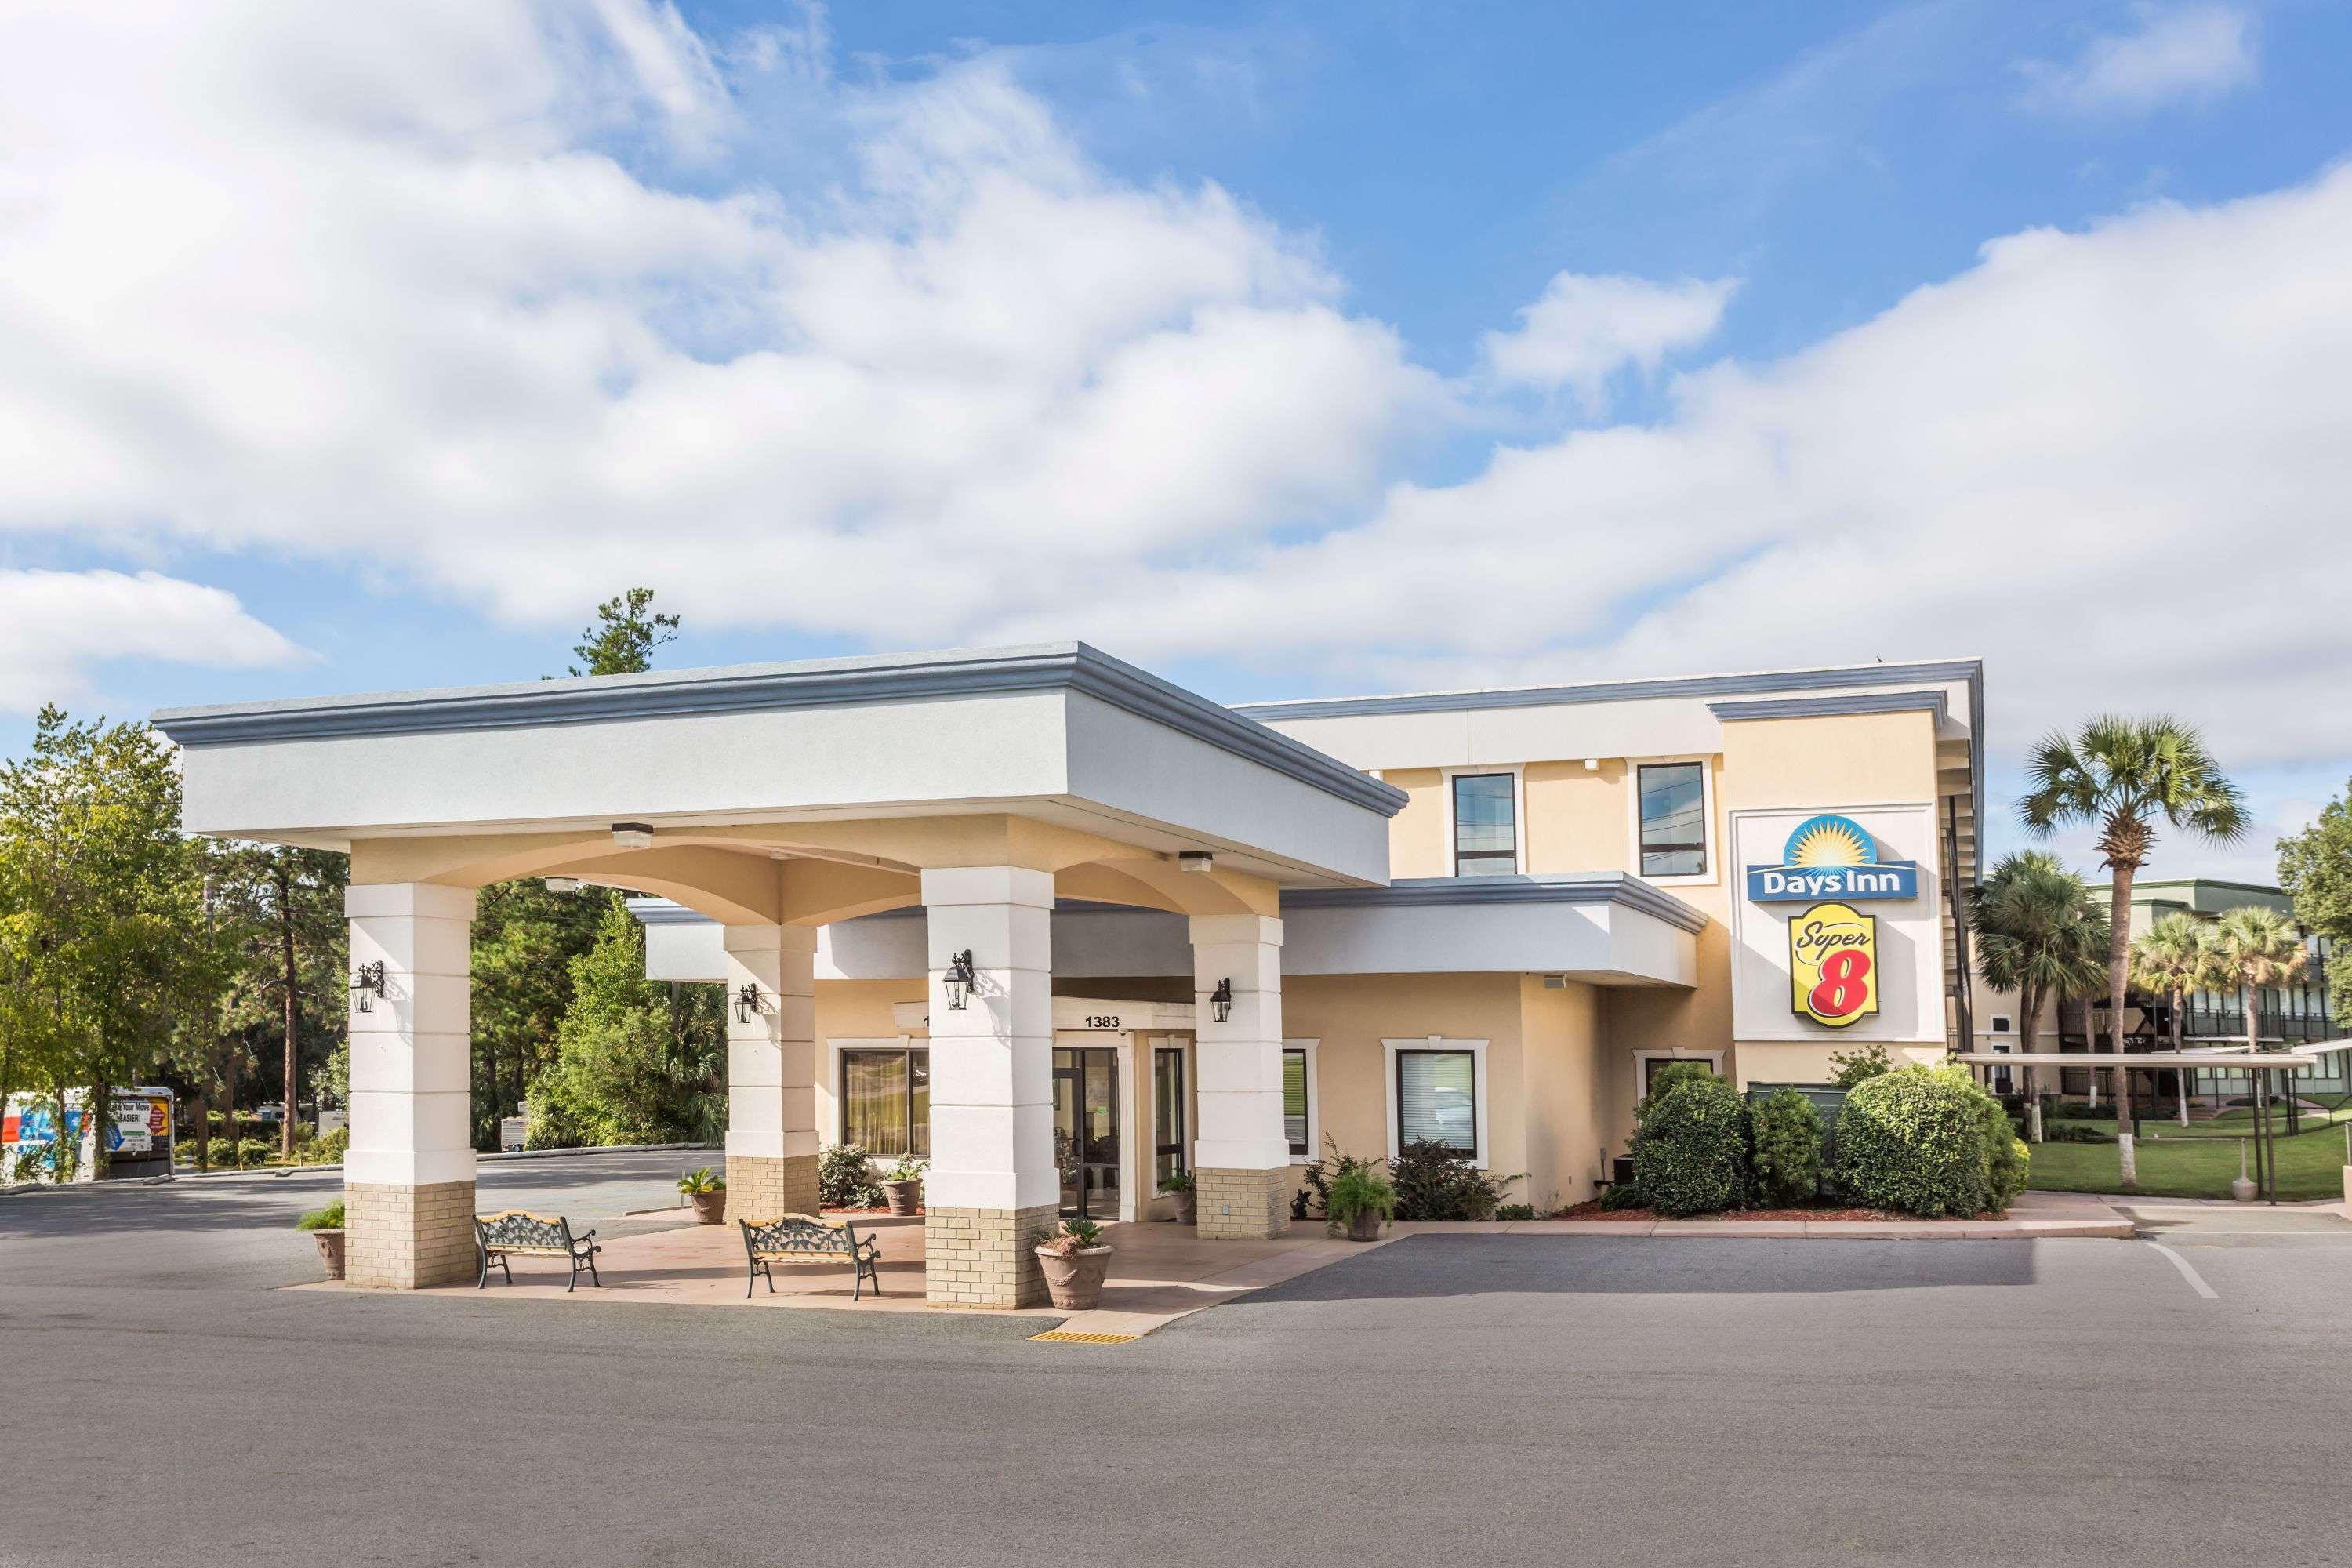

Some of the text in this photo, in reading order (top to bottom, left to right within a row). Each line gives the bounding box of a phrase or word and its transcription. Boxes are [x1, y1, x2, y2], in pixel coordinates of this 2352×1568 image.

[1764, 870, 1900, 895] Days Inn
[1796, 920, 1871, 961] Super
[1807, 949, 1871, 1018] 8
[1085, 1016, 1120, 1028] 1383
[122, 1102, 134, 1111] Your
[135, 1102, 150, 1111] Move
[120, 1113, 141, 1123] EASIER!
